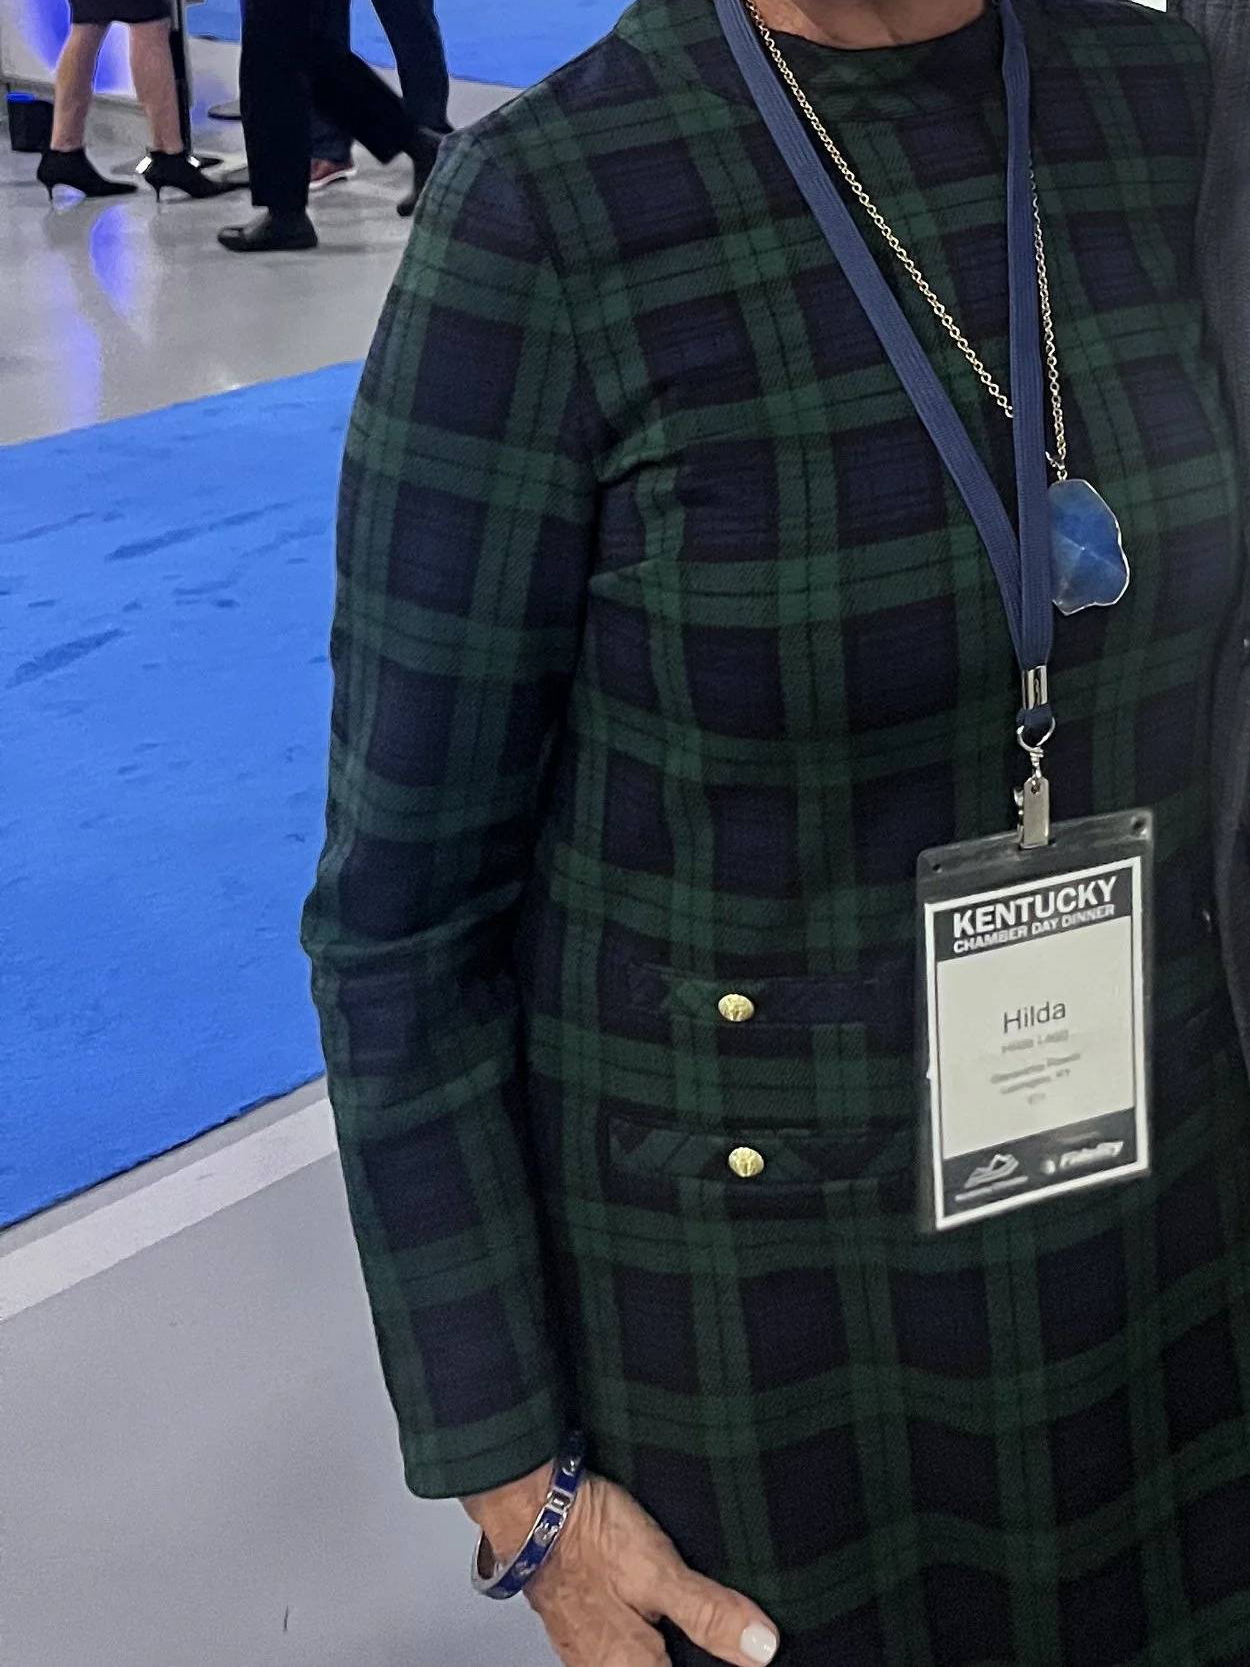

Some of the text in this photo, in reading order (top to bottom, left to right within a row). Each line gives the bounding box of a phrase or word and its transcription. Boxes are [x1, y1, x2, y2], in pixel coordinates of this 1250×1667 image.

[953, 876, 1117, 938] KENTUCKY
[953, 904, 1115, 953] CHAMBER DAY DINNER
[1004, 1001, 1066, 1034] Hilda
